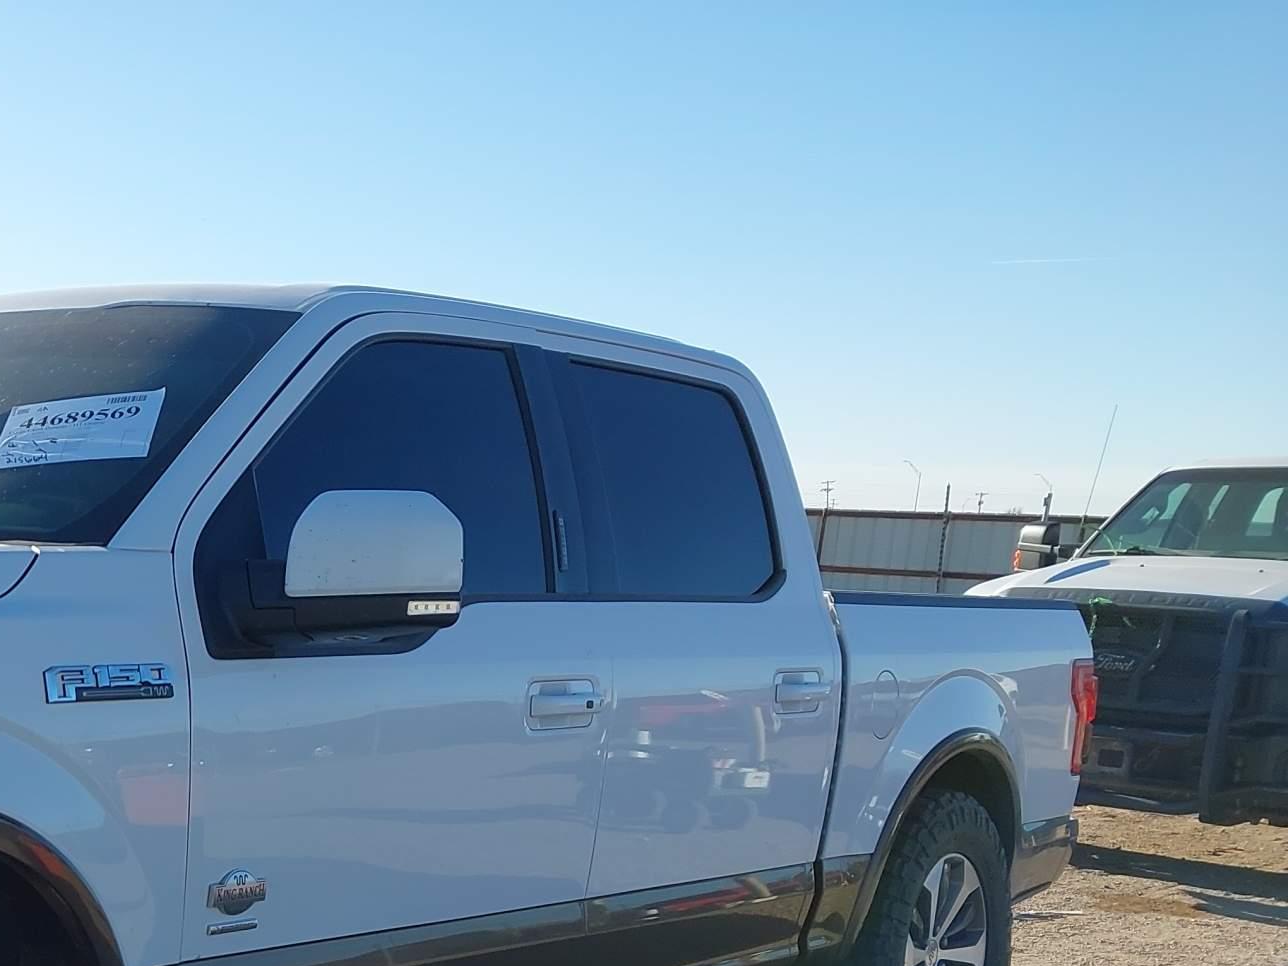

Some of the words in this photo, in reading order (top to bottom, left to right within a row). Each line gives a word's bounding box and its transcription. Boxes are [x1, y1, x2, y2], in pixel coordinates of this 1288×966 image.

[19, 405, 141, 429] 44689569
[1095, 653, 1136, 672] Ford
[216, 886, 237, 902] KING
[238, 883, 265, 899] RANCH
